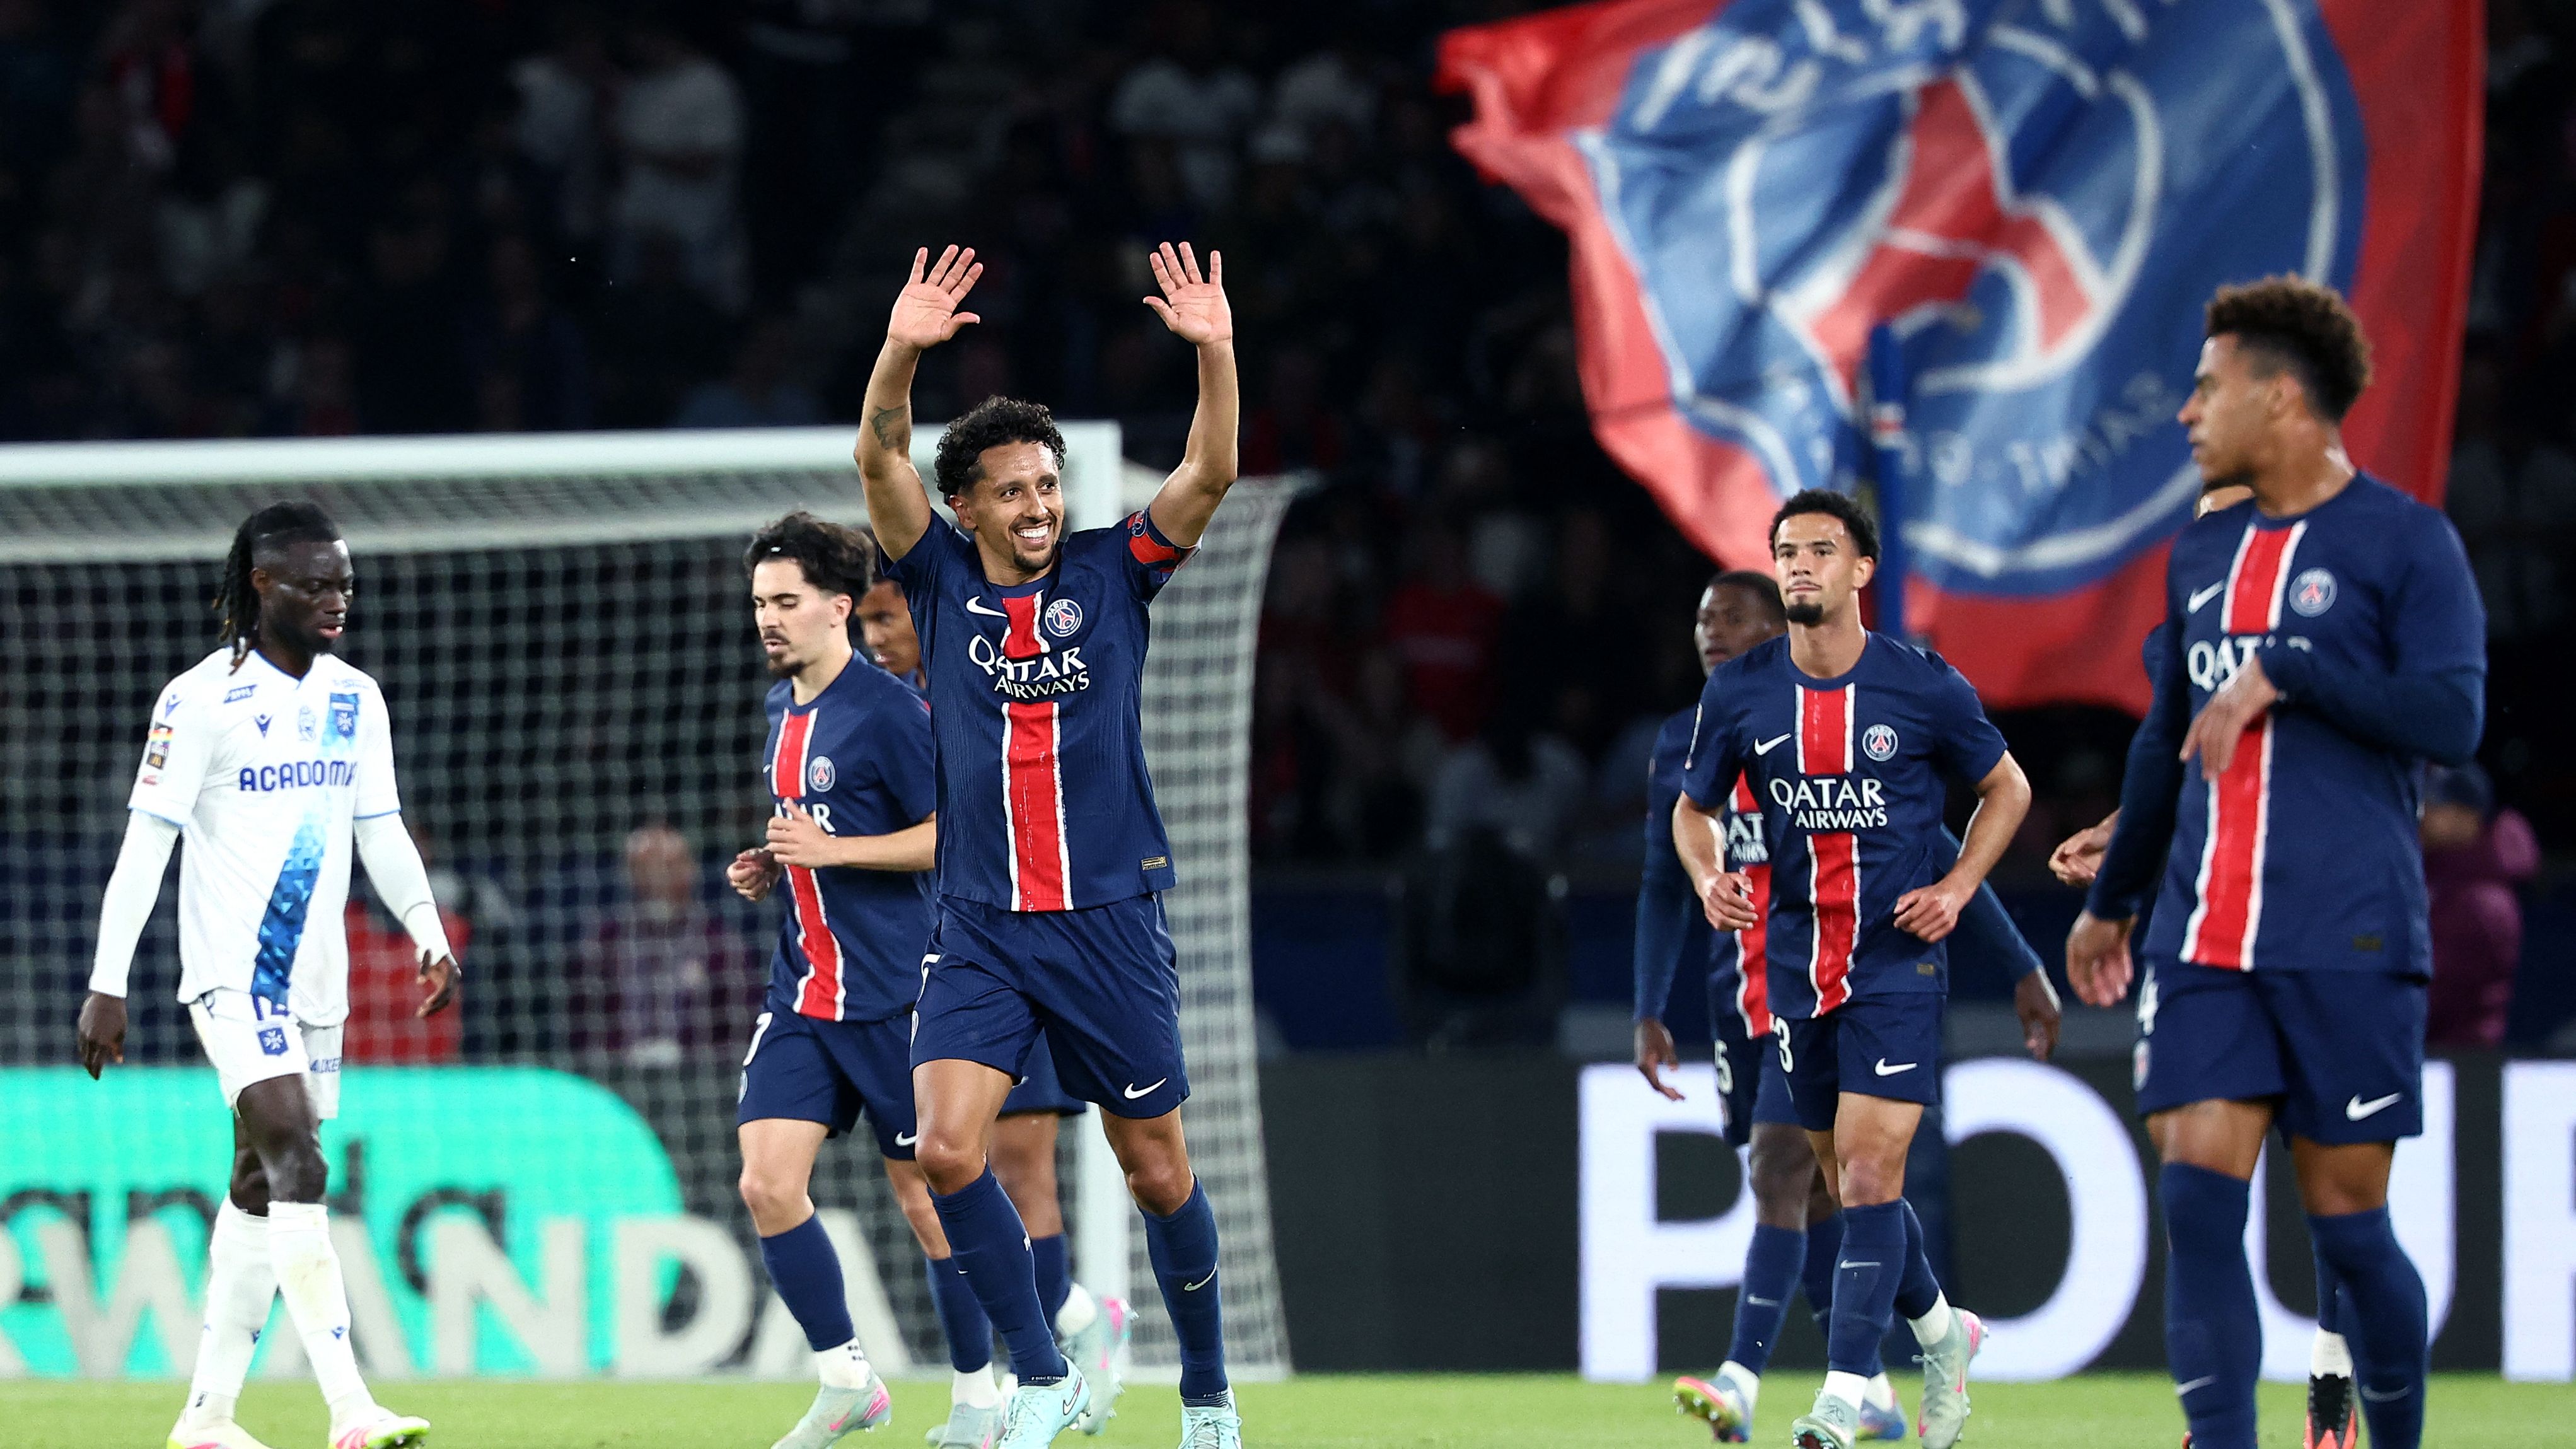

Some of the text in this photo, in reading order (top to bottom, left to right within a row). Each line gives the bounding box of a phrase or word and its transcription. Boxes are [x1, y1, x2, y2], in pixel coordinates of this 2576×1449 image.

[1047, 601, 1069, 618] PARIS
[969, 634, 1087, 682] QATAR
[2188, 636, 2313, 692] QAT
[994, 671, 1089, 699] AIRWAYS
[1769, 777, 1886, 815] QATAR
[1795, 806, 1888, 829] AIRWAYS
[1773, 1016, 1794, 1073] 3
[1714, 1039, 1733, 1095] 5
